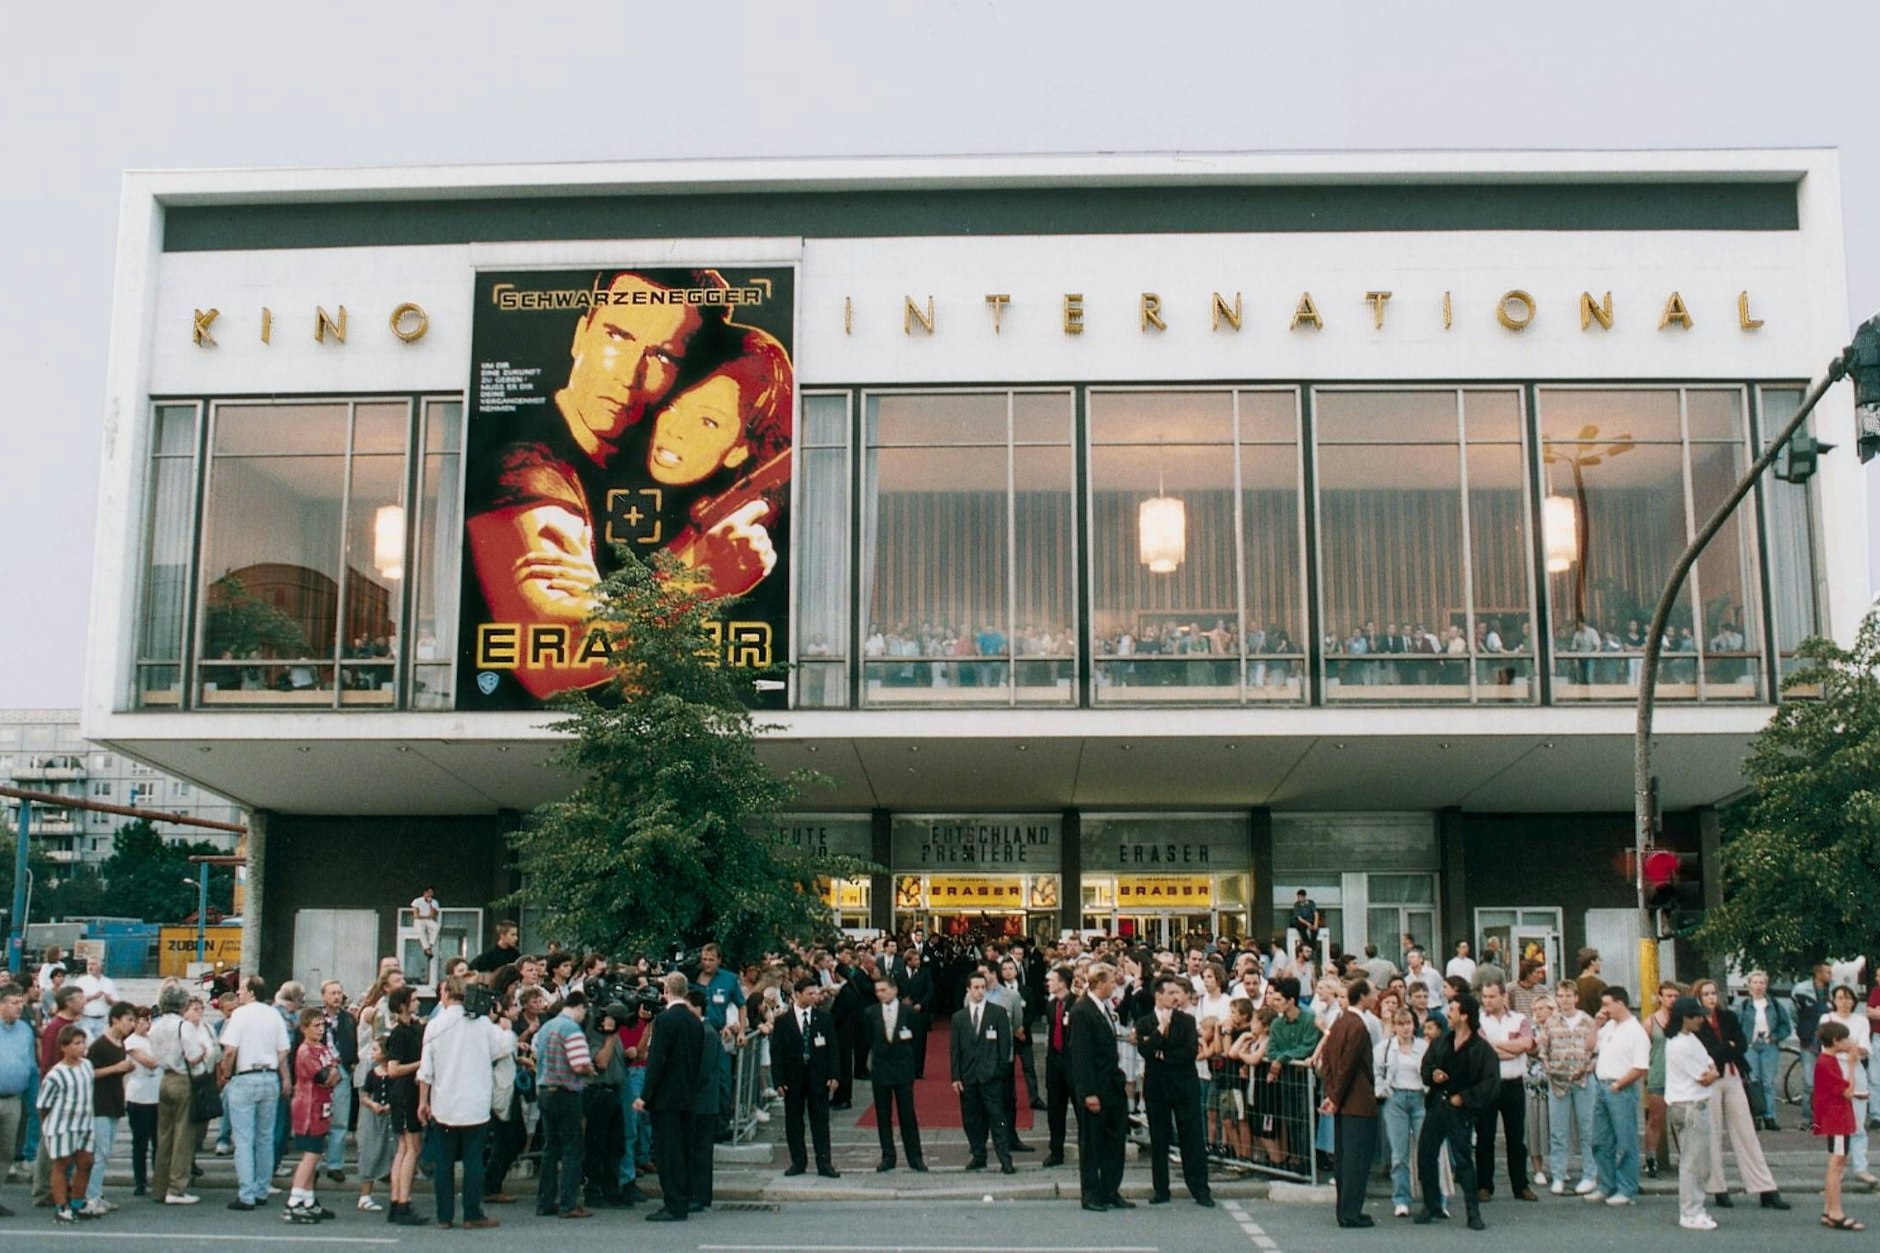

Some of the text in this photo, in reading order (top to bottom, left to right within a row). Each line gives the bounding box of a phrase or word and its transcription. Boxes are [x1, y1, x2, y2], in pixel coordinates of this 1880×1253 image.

[500, 287, 763, 310] SCHWARZENEGGER
[193, 288, 1765, 348] KINO INTERNATIONAL
[477, 621, 772, 669] ERAER
[921, 844, 1027, 863] PREMIERE
[1119, 844, 1209, 863] ERASER
[932, 886, 1020, 896] ERASER
[1120, 886, 1208, 896] ERASER
